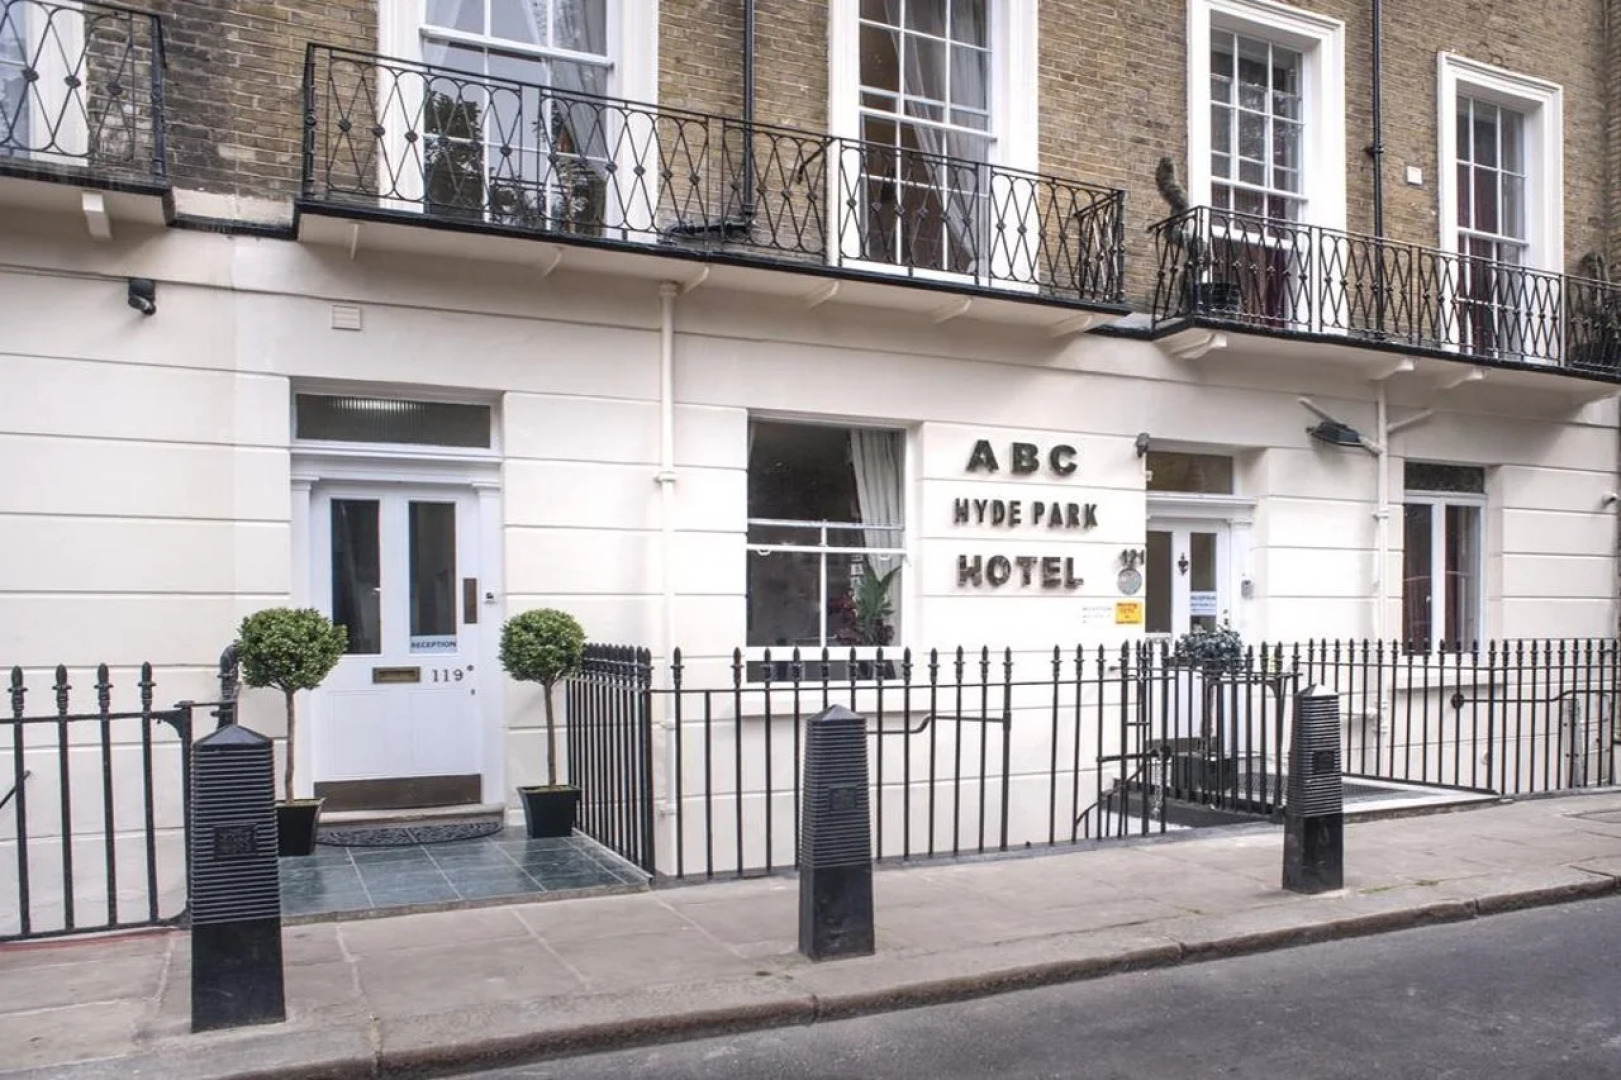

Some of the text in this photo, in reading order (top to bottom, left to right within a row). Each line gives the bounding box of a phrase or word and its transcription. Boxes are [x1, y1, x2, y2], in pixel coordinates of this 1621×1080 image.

[966, 440, 1077, 475] ABC
[954, 498, 1098, 528] HYDE PARK
[958, 555, 1083, 588] HOTEL
[432, 669, 464, 682] 119
